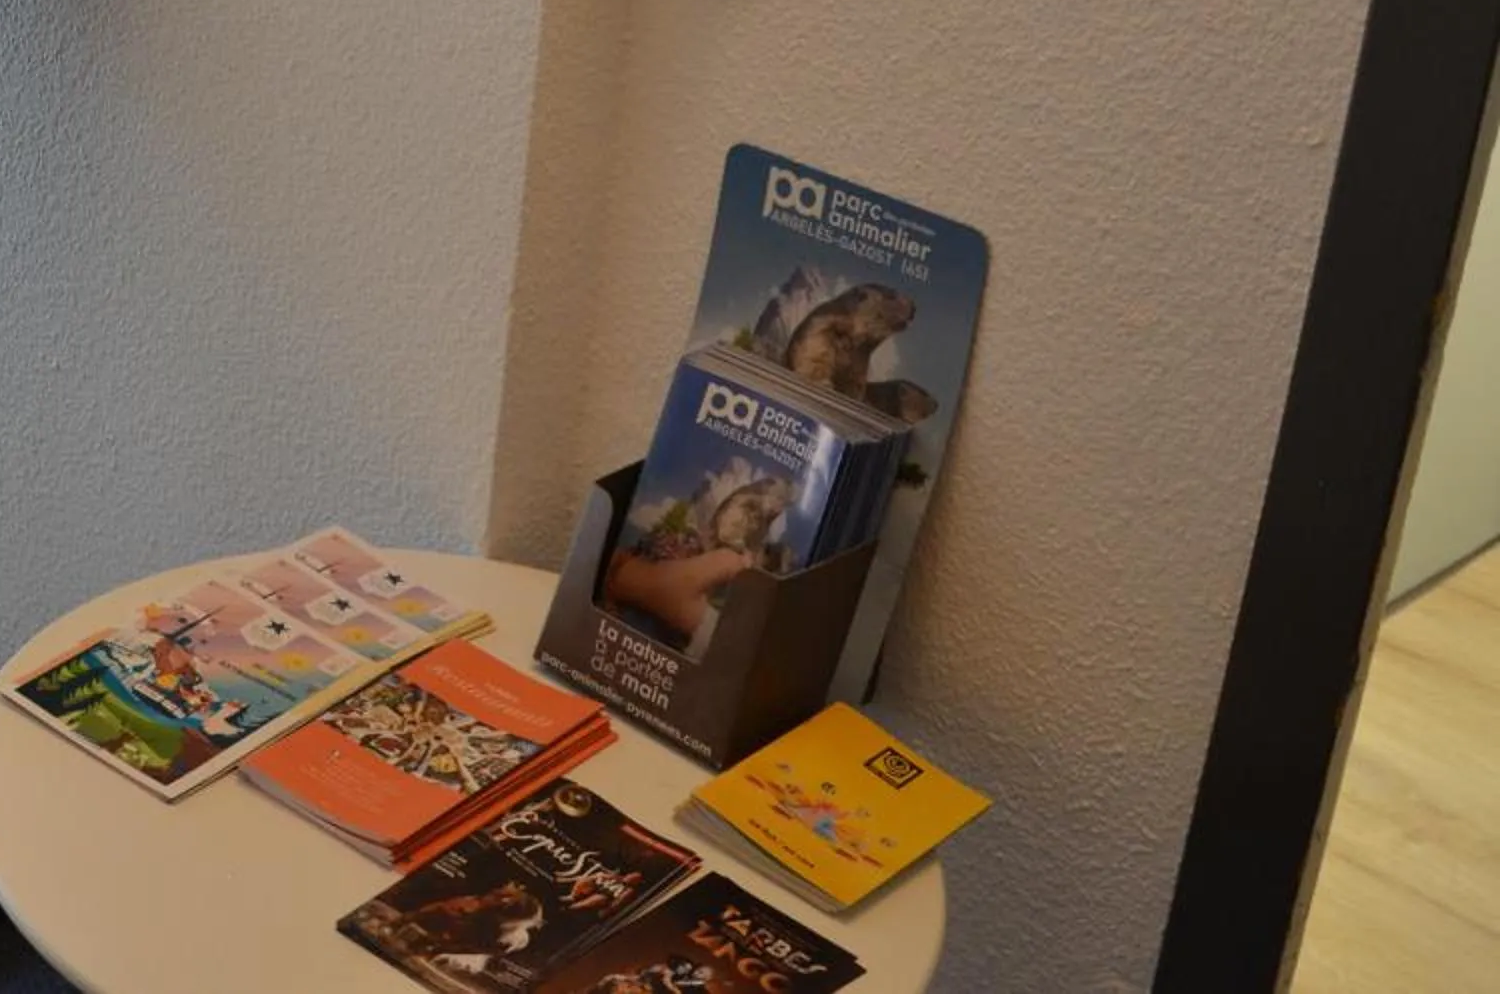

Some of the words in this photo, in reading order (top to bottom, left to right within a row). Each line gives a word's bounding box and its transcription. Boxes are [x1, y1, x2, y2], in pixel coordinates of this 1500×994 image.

[831, 189, 884, 222] parc
[828, 208, 933, 261] animalier
[762, 406, 803, 434] parc
[599, 619, 619, 643] La
[621, 632, 680, 676] nature
[614, 647, 675, 692] portée
[590, 652, 617, 680] de
[620, 667, 671, 711] main
